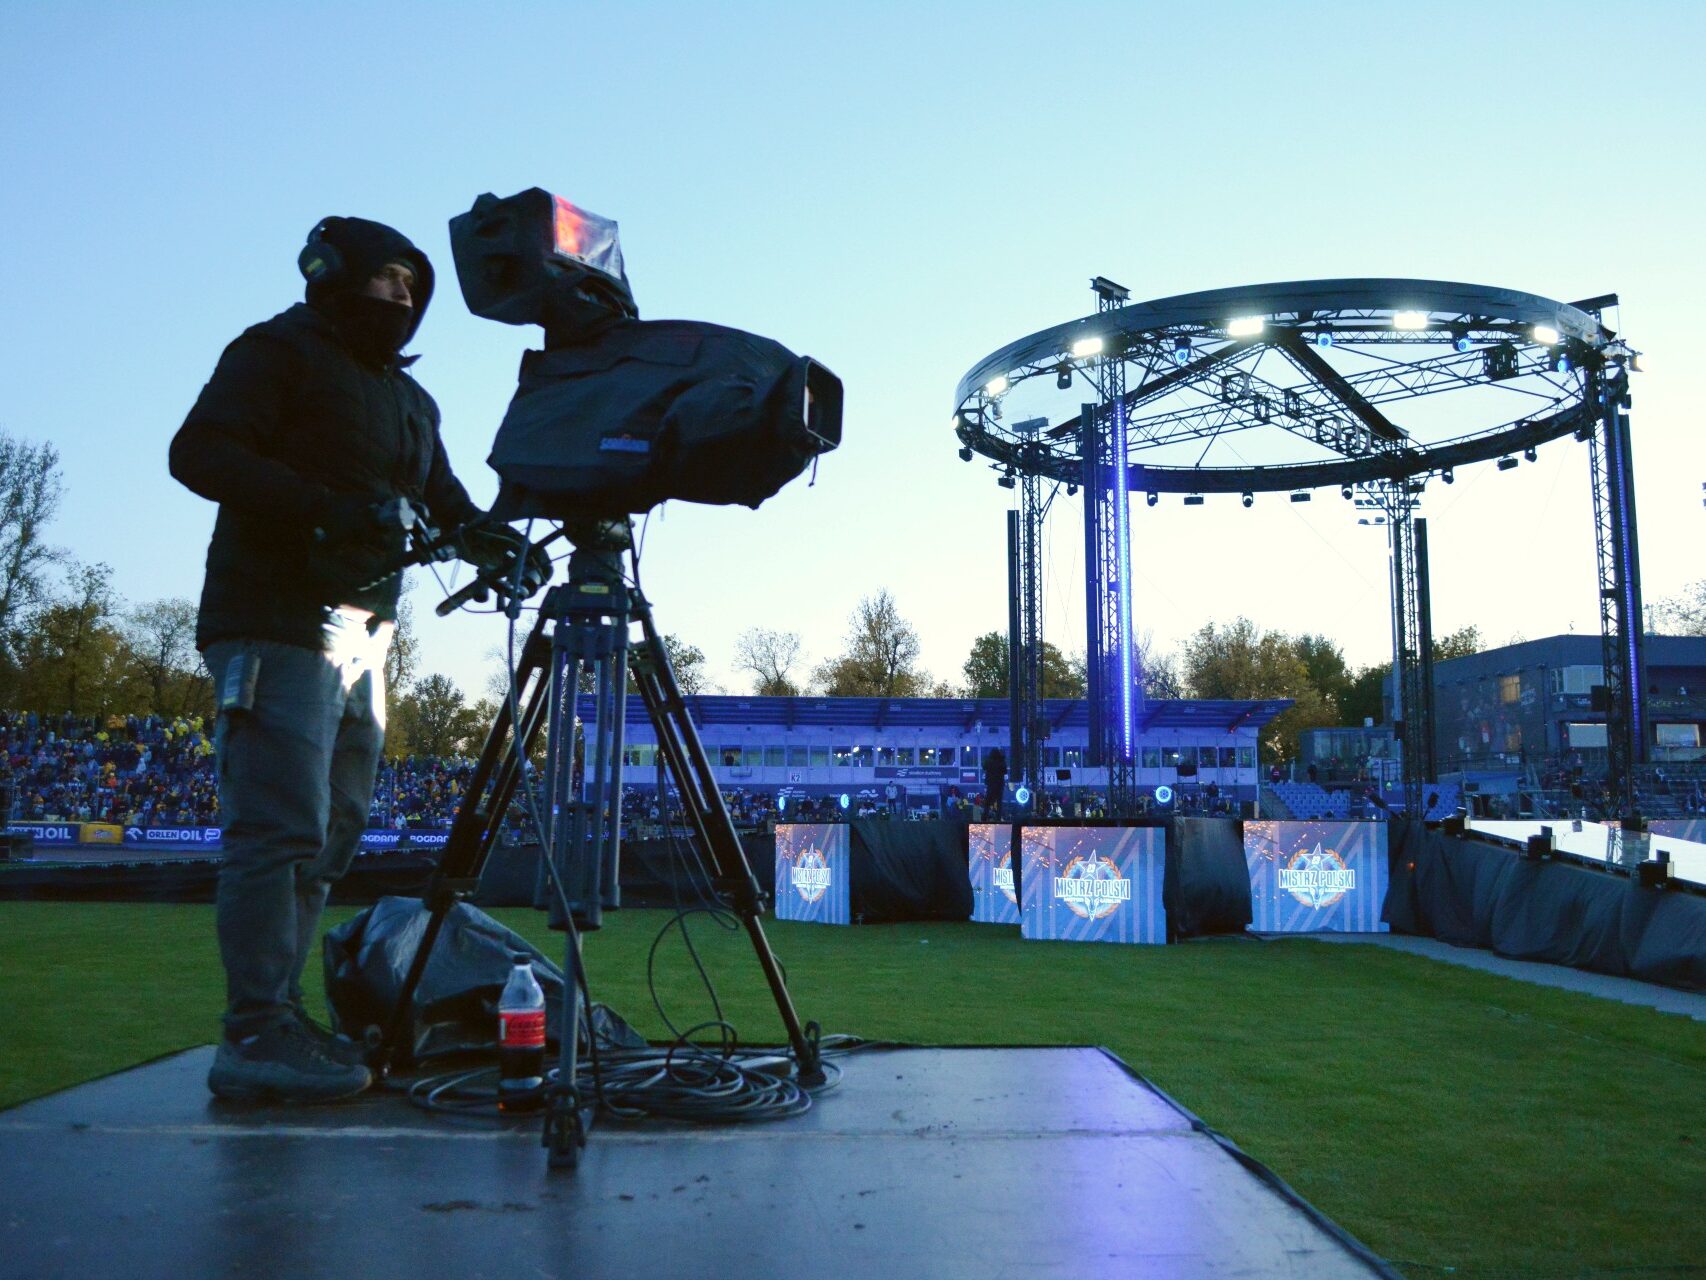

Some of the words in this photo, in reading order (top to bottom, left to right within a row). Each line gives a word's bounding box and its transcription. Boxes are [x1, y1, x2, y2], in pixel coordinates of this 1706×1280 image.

[45, 827, 72, 839] OIL
[147, 830, 179, 839] ORLEN
[180, 830, 201, 840] OIL
[360, 834, 400, 842] OGDANK
[410, 835, 449, 843] BOGDAN
[993, 868, 1013, 885] MIST
[1280, 870, 1317, 887] MISTRZ
[1320, 871, 1354, 888] POLSKI
[1055, 878, 1092, 897] MISTRZ
[1095, 880, 1130, 899] POLSKI
